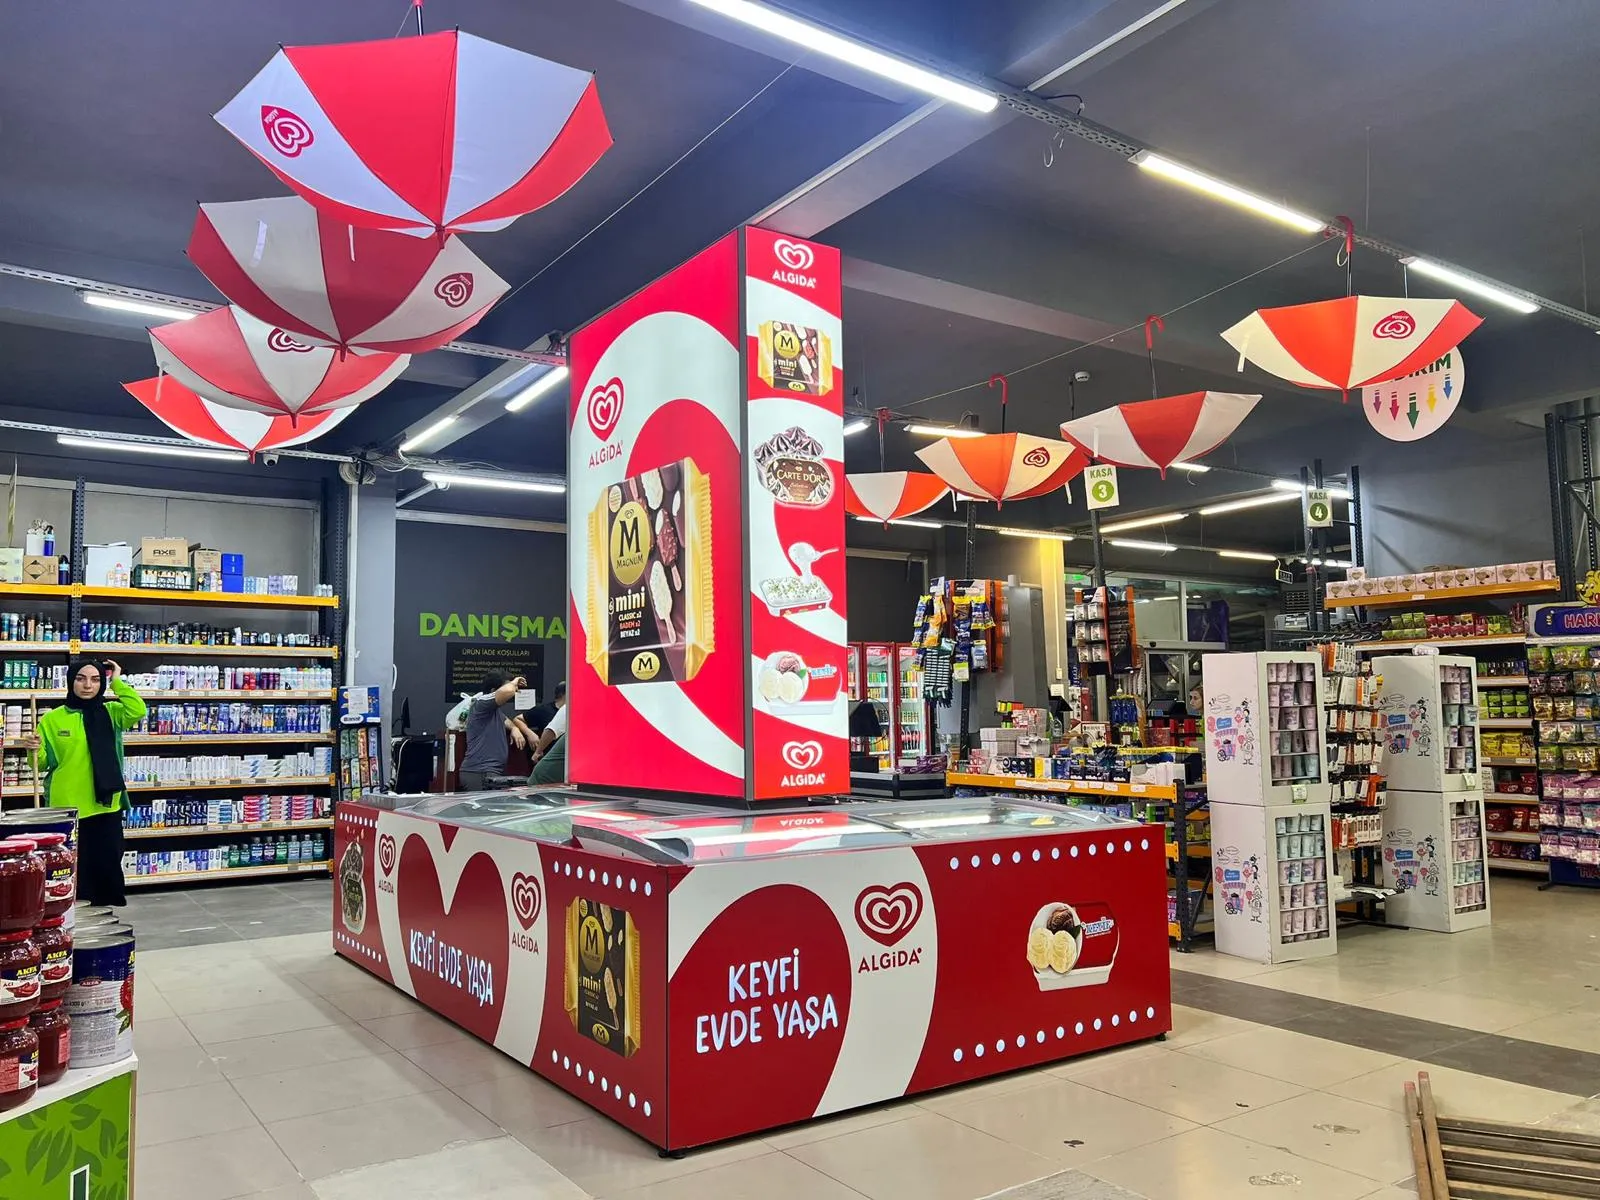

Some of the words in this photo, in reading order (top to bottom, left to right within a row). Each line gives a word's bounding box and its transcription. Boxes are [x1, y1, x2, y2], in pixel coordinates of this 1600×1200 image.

[780, 335, 793, 349] M
[777, 470, 801, 480] CARTE
[1089, 467, 1113, 480] KASA
[1099, 484, 1108, 499] 3
[1309, 490, 1328, 500] KASA
[1314, 505, 1323, 518] 4
[619, 516, 641, 557] M
[616, 555, 644, 569] MAGNUM
[615, 586, 646, 612] mini
[420, 612, 567, 642] DANIŞMA
[497, 649, 530, 657] KOŞULLARI
[638, 657, 653, 670] M
[585, 925, 599, 955] M
[46, 950, 68, 961] AKFA
[16, 966, 38, 977] AKFA
[410, 928, 435, 973] KEYFİ
[438, 941, 463, 988] EVDE
[466, 954, 494, 1007] YAŞA
[728, 947, 800, 1003] KEYFİ
[582, 975, 601, 991] mini
[696, 1005, 762, 1054] EVDE
[772, 993, 839, 1040] YAŞA
